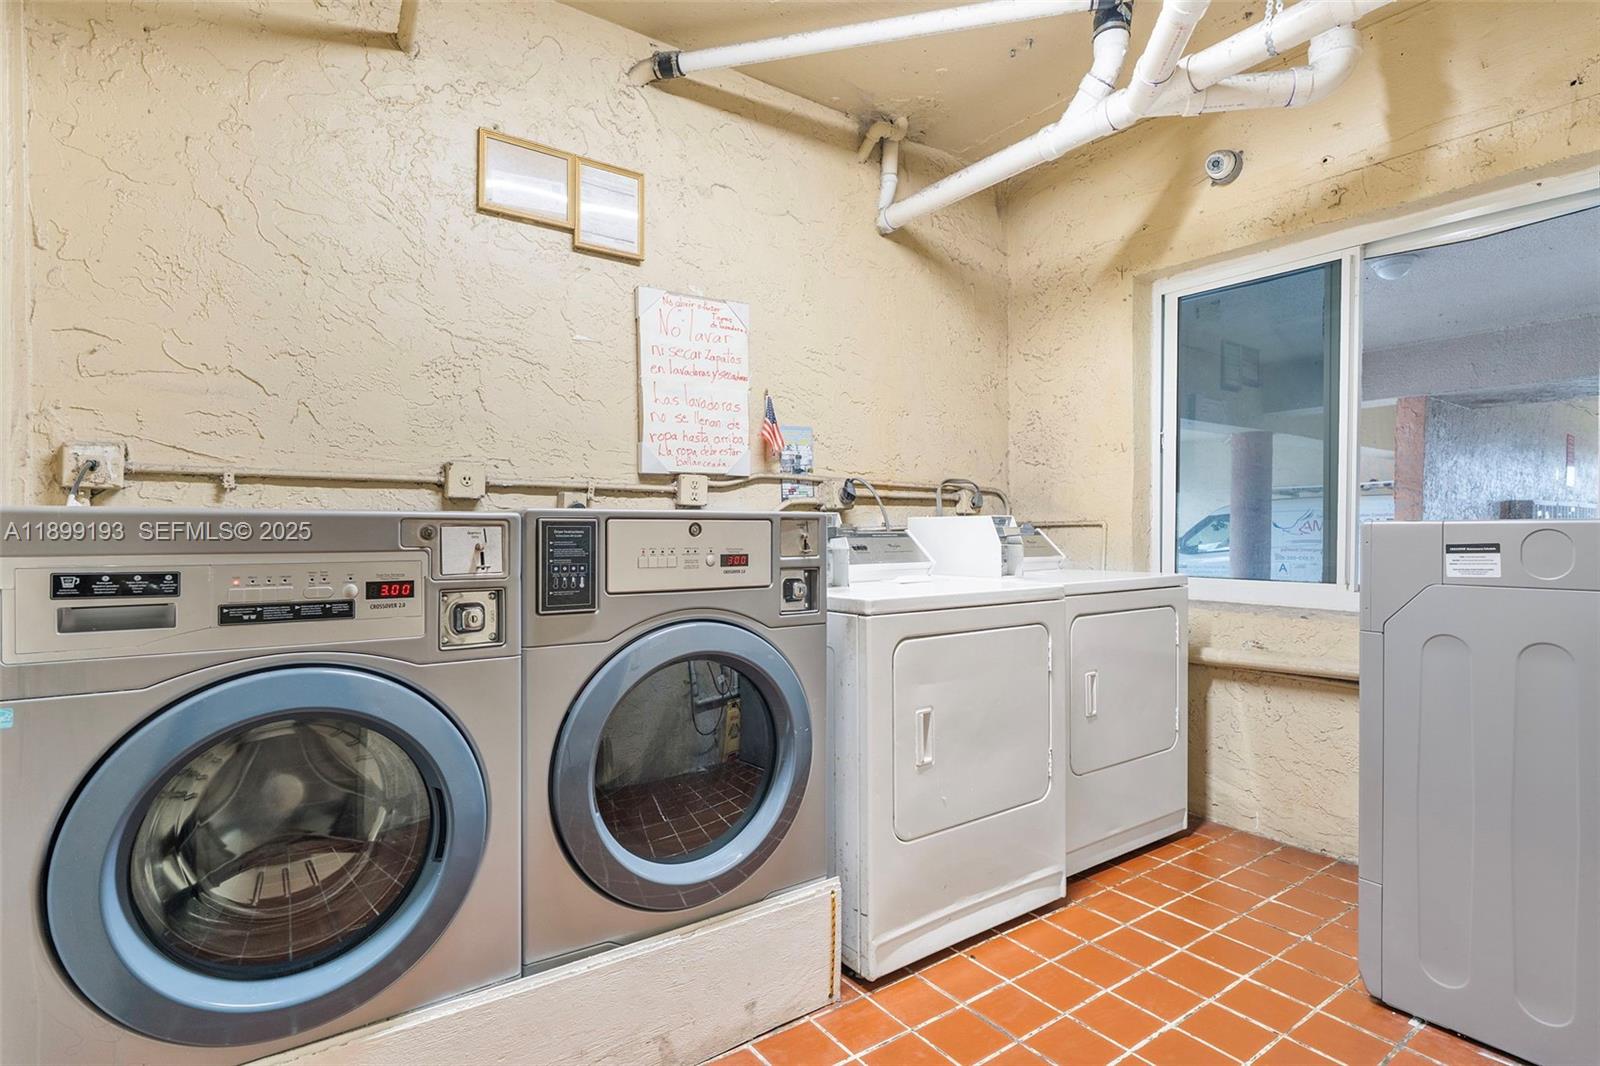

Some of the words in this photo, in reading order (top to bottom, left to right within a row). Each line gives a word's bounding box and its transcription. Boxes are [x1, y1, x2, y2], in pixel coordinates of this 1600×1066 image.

[662, 295, 674, 307] No
[658, 307, 681, 337] No
[690, 308, 731, 343] lavar
[651, 344, 664, 357] ni
[669, 345, 702, 361] secar
[650, 364, 665, 375] en
[653, 380, 680, 406] Las
[683, 383, 742, 413] lavadoras
[650, 410, 666, 423] no
[674, 413, 688, 424] se
[726, 418, 740, 431] de
[649, 431, 678, 449] ropa
[682, 426, 709, 444] hasta
[658, 443, 672, 457] La
[676, 447, 697, 460] ropa
[719, 443, 742, 457] estar
[380, 583, 411, 597] 3.00
[369, 602, 398, 610] CROSSOVER
